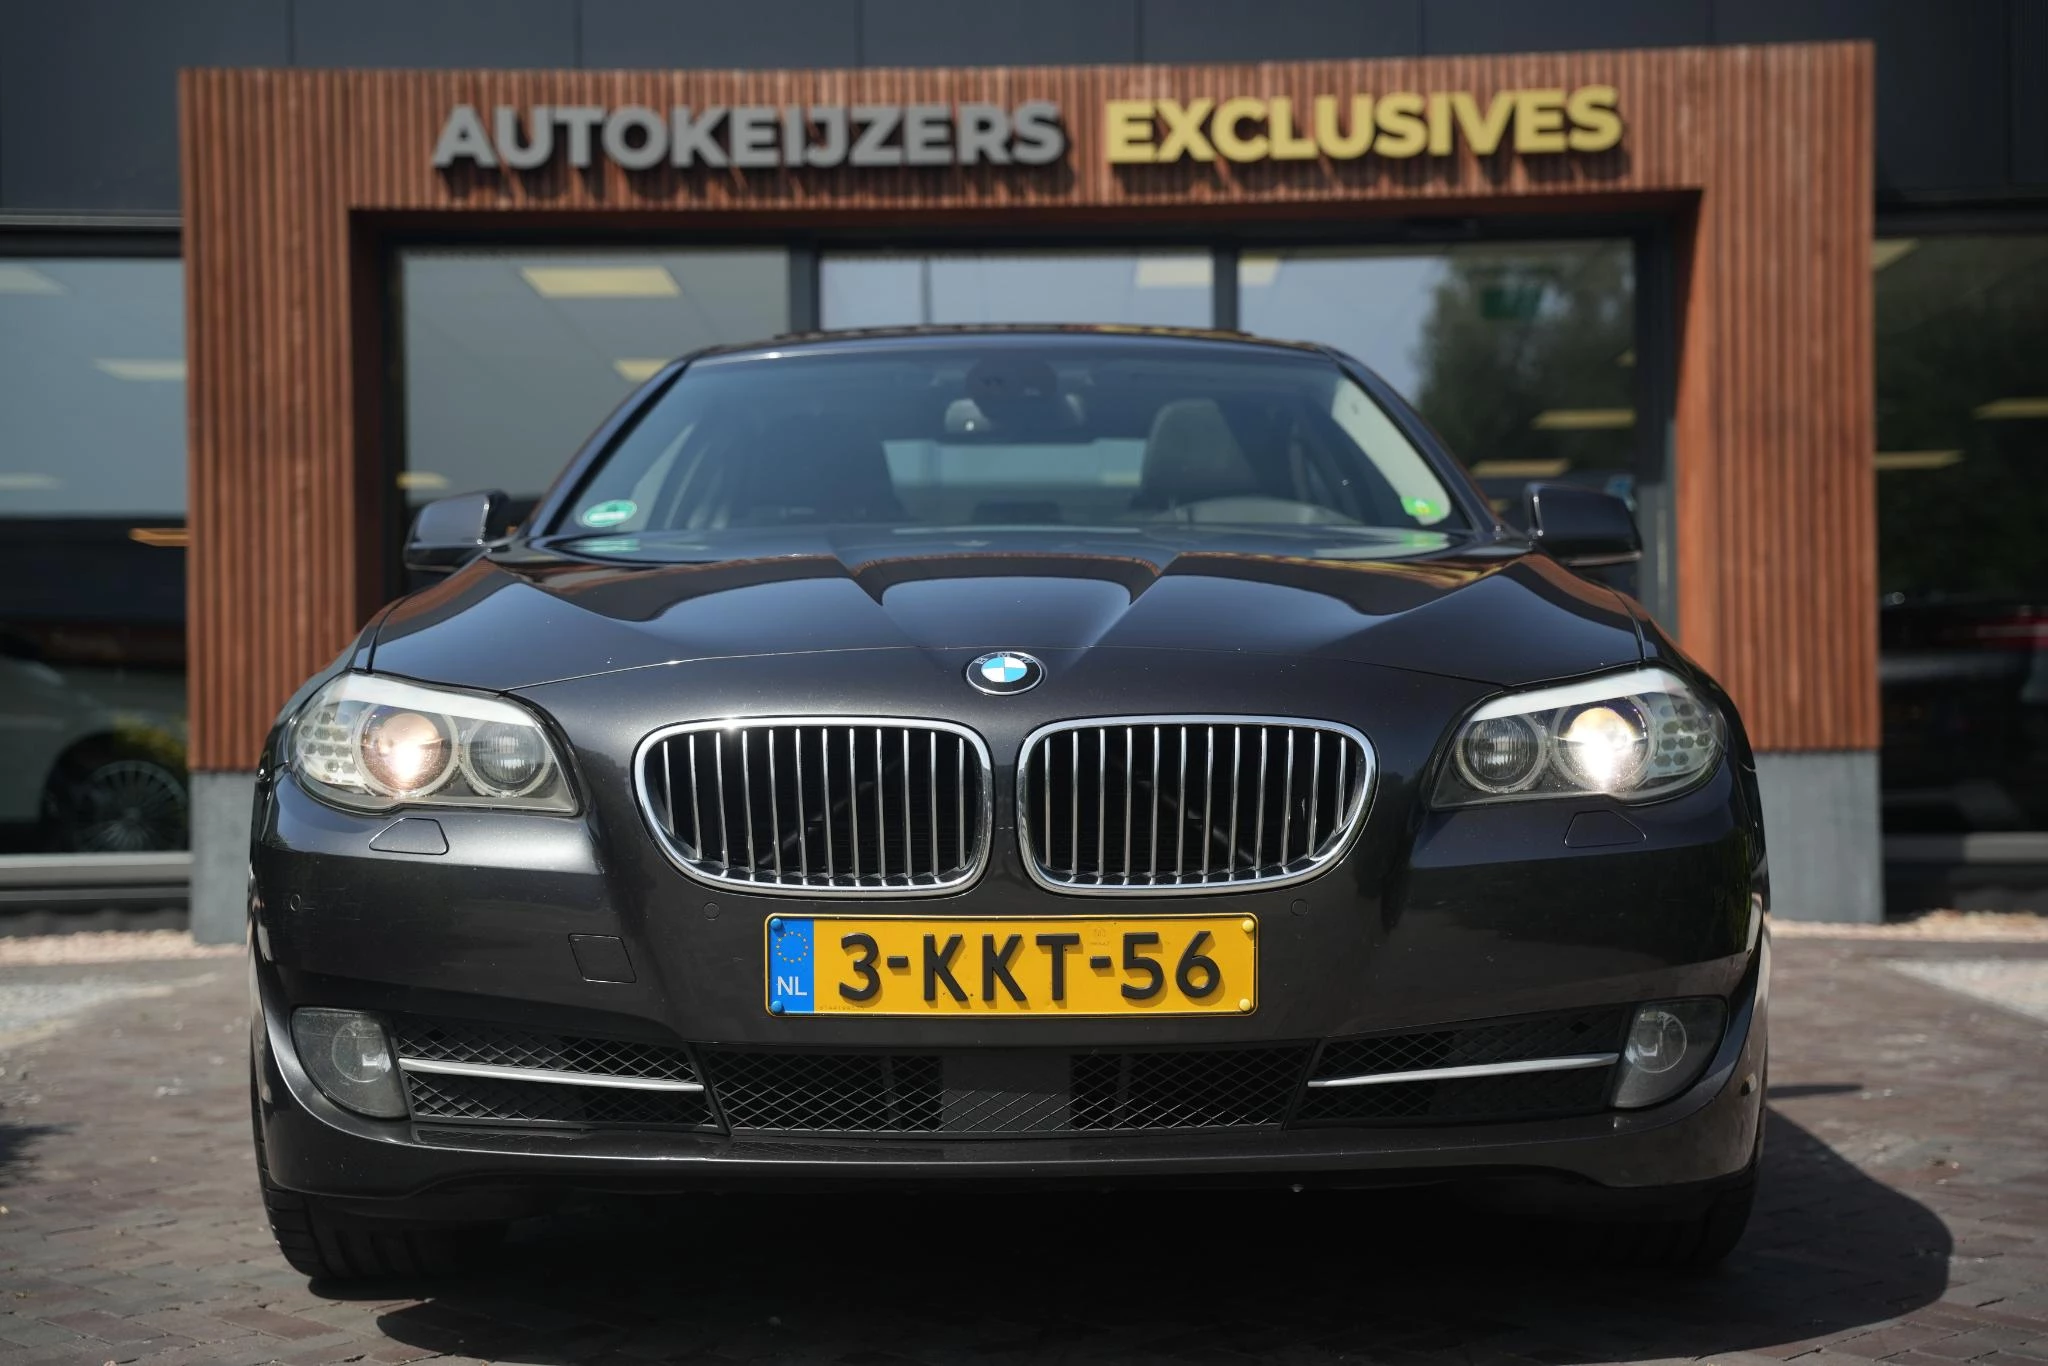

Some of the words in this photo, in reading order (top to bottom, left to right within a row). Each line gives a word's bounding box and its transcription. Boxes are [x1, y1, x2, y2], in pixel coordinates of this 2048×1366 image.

[431, 101, 1066, 169] AUTOKEIJZERS
[1105, 85, 1623, 164] EXCLUSIVES
[776, 976, 807, 996] NL
[838, 930, 1222, 1001] 3-KKT-56
